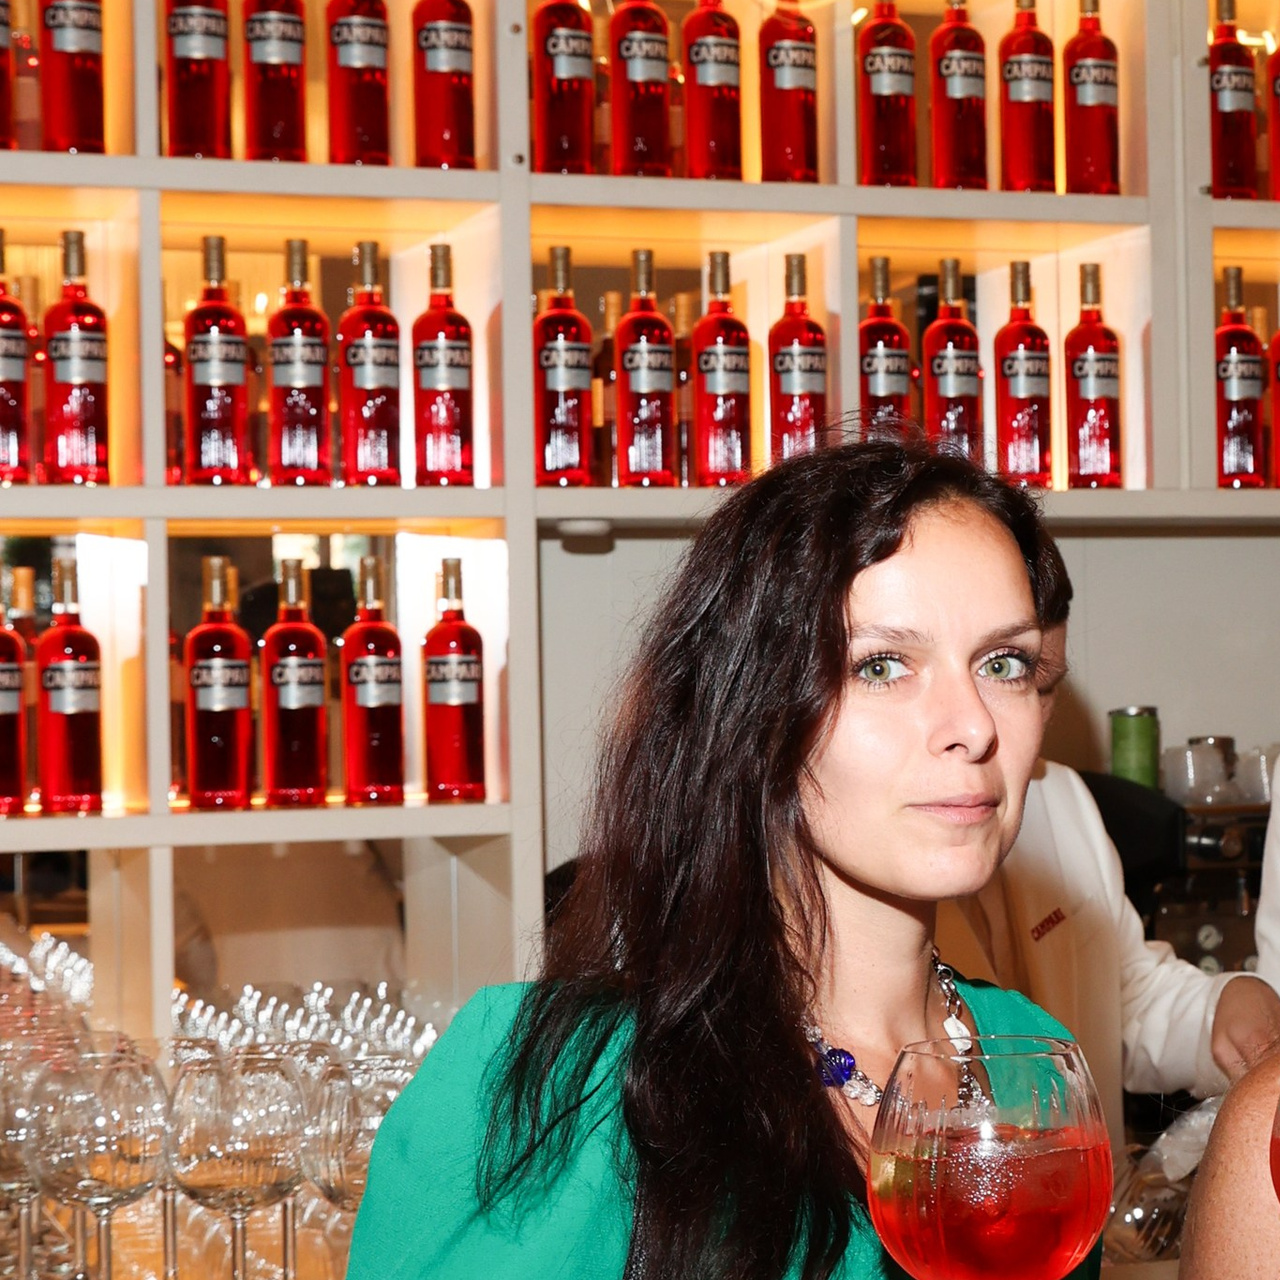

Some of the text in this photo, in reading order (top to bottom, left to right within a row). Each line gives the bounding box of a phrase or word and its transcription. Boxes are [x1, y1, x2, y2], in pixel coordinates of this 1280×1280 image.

[46, 7, 100, 29] CAMPA
[170, 15, 227, 35] CAMPAR
[248, 20, 303, 41] CAMPAR
[333, 24, 387, 45] CAMPA
[420, 30, 472, 49] CAMPA
[548, 36, 592, 55] CAMP
[622, 40, 667, 58] CAMPA
[691, 44, 739, 64] CAMPA
[769, 47, 815, 67] CAMPA
[866, 55, 914, 74] CAMPA
[941, 59, 984, 78] CAMPA
[1005, 61, 1053, 81] CAMPA
[1072, 66, 1117, 84] CAMPA
[1214, 73, 1254, 92] CAMPA
[348, 346, 399, 366] CAMPA
[417, 346, 471, 366] CAMPAR
[542, 348, 591, 367] CAMPA
[625, 350, 672, 368] CAMPA
[701, 352, 749, 370] CAMPA
[776, 354, 825, 373] CAMPA
[863, 354, 909, 372] CAMPA
[934, 357, 978, 374] CAMPA
[1005, 359, 1049, 377] CAMPA
[1075, 360, 1118, 378] CAMPA
[1219, 362, 1263, 380] CAMPA
[44, 670, 100, 686] CAMPA
[192, 667, 248, 684] CAMPAR
[273, 667, 324, 684] CAMPA
[351, 666, 401, 683] CAMPA
